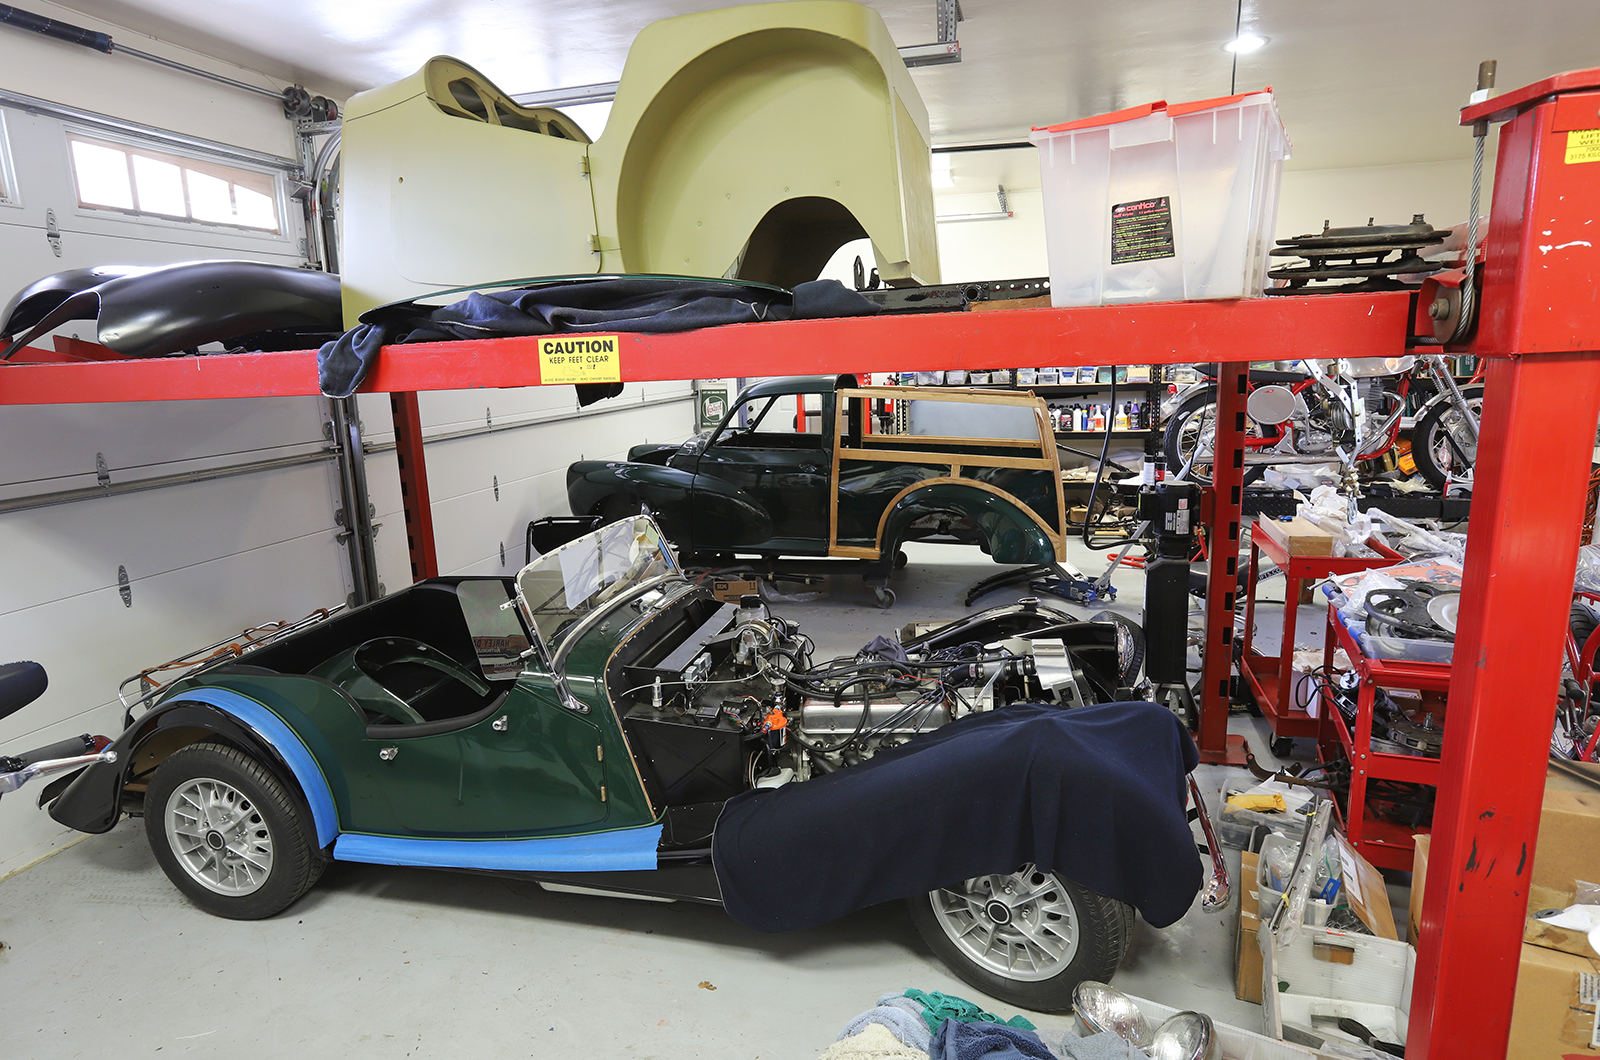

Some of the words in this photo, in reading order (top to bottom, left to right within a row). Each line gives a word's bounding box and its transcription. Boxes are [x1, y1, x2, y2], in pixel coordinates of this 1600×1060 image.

[1569, 152, 1586, 161] 3175
[544, 340, 613, 354] CAUTION
[586, 355, 609, 363] CLEAR
